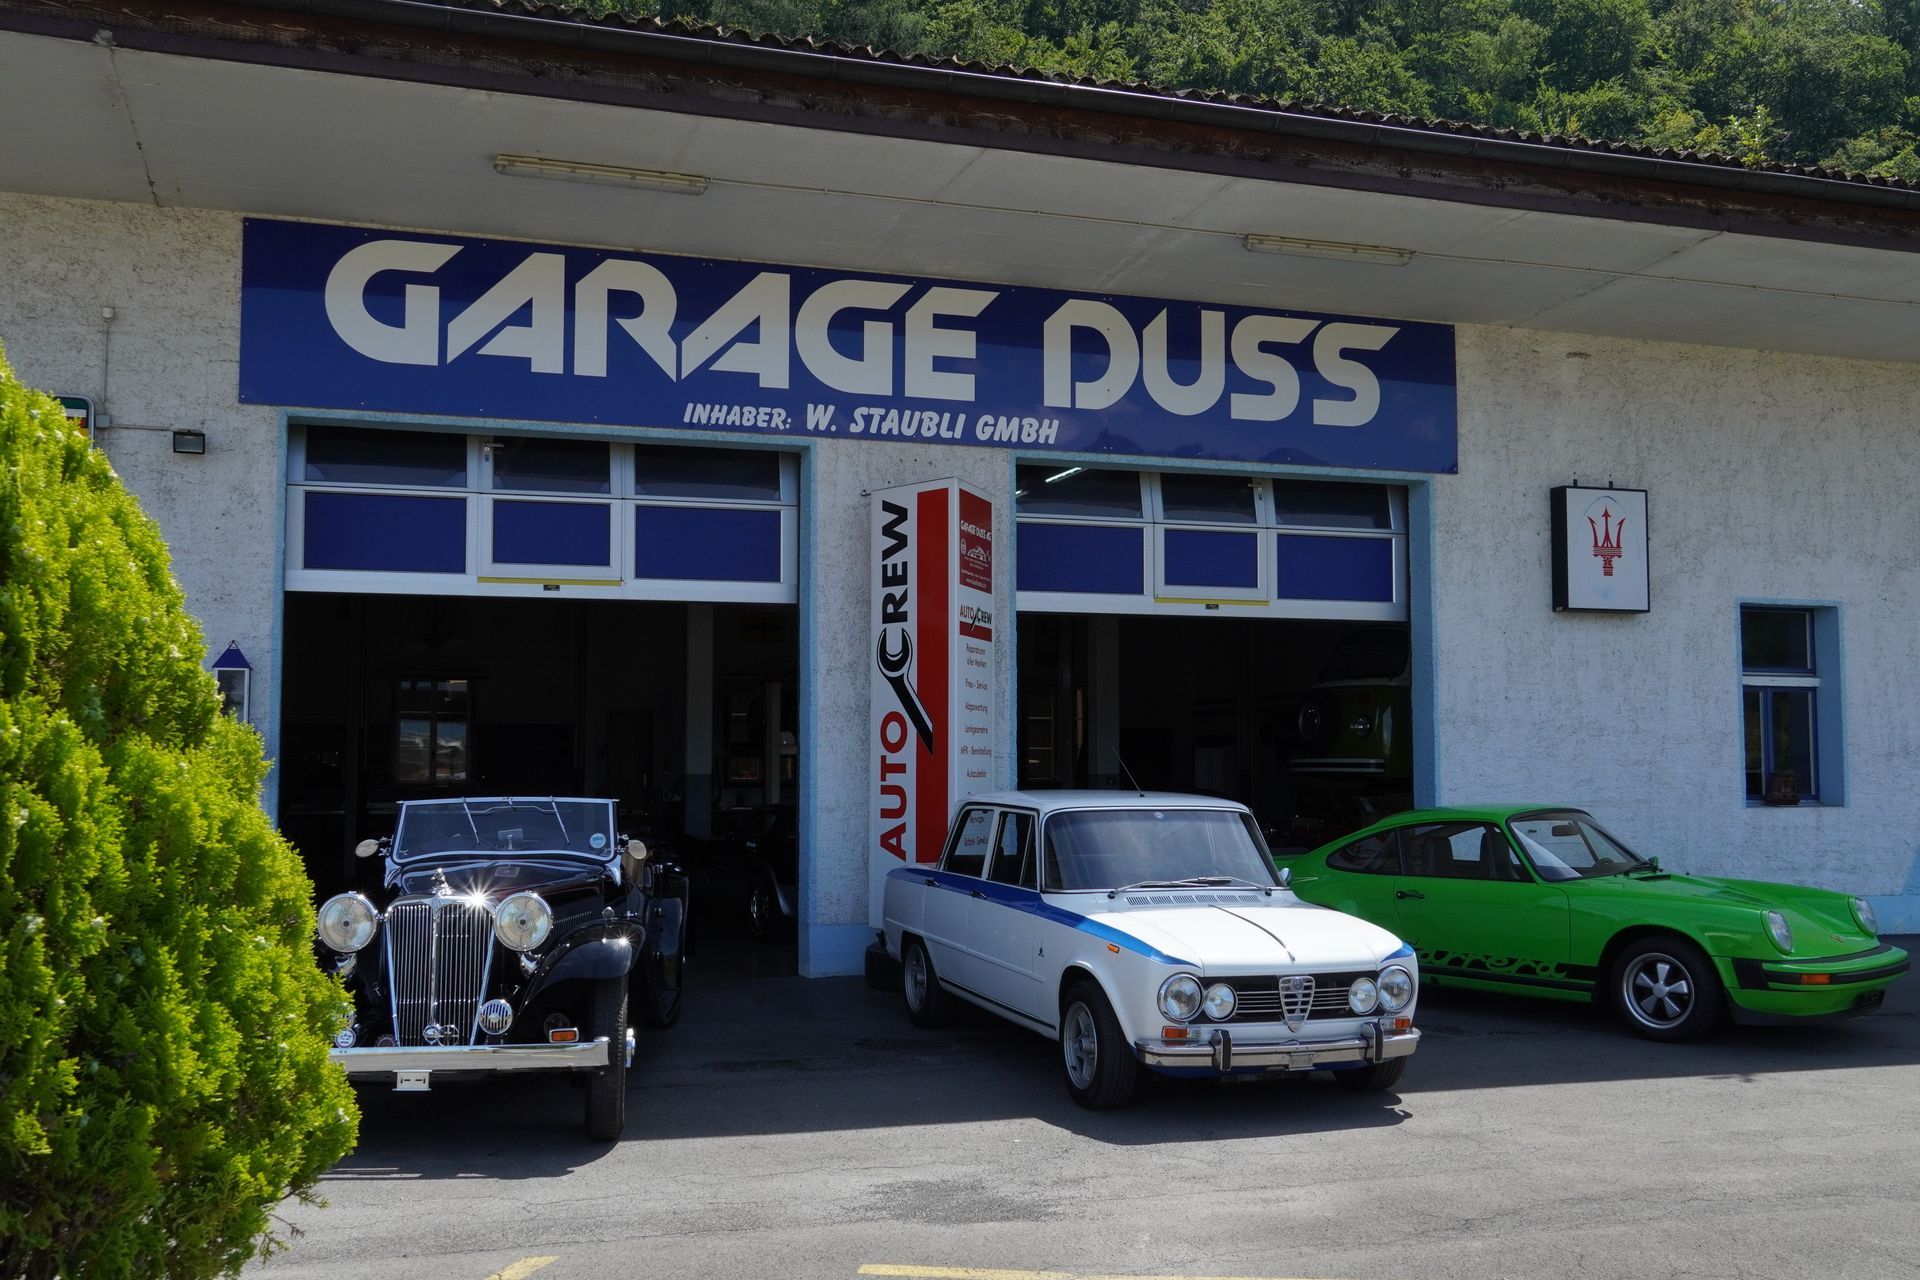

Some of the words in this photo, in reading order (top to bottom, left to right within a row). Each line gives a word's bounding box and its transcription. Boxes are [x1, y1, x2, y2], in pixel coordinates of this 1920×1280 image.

[325, 240, 1000, 401] GARAGE
[1044, 299, 1401, 427] DUSS
[683, 403, 792, 430] INHABER:
[806, 403, 836, 432] W.
[850, 407, 967, 439] STAUBLI
[976, 414, 1060, 444] GMBH
[880, 711, 908, 862] AUTO
